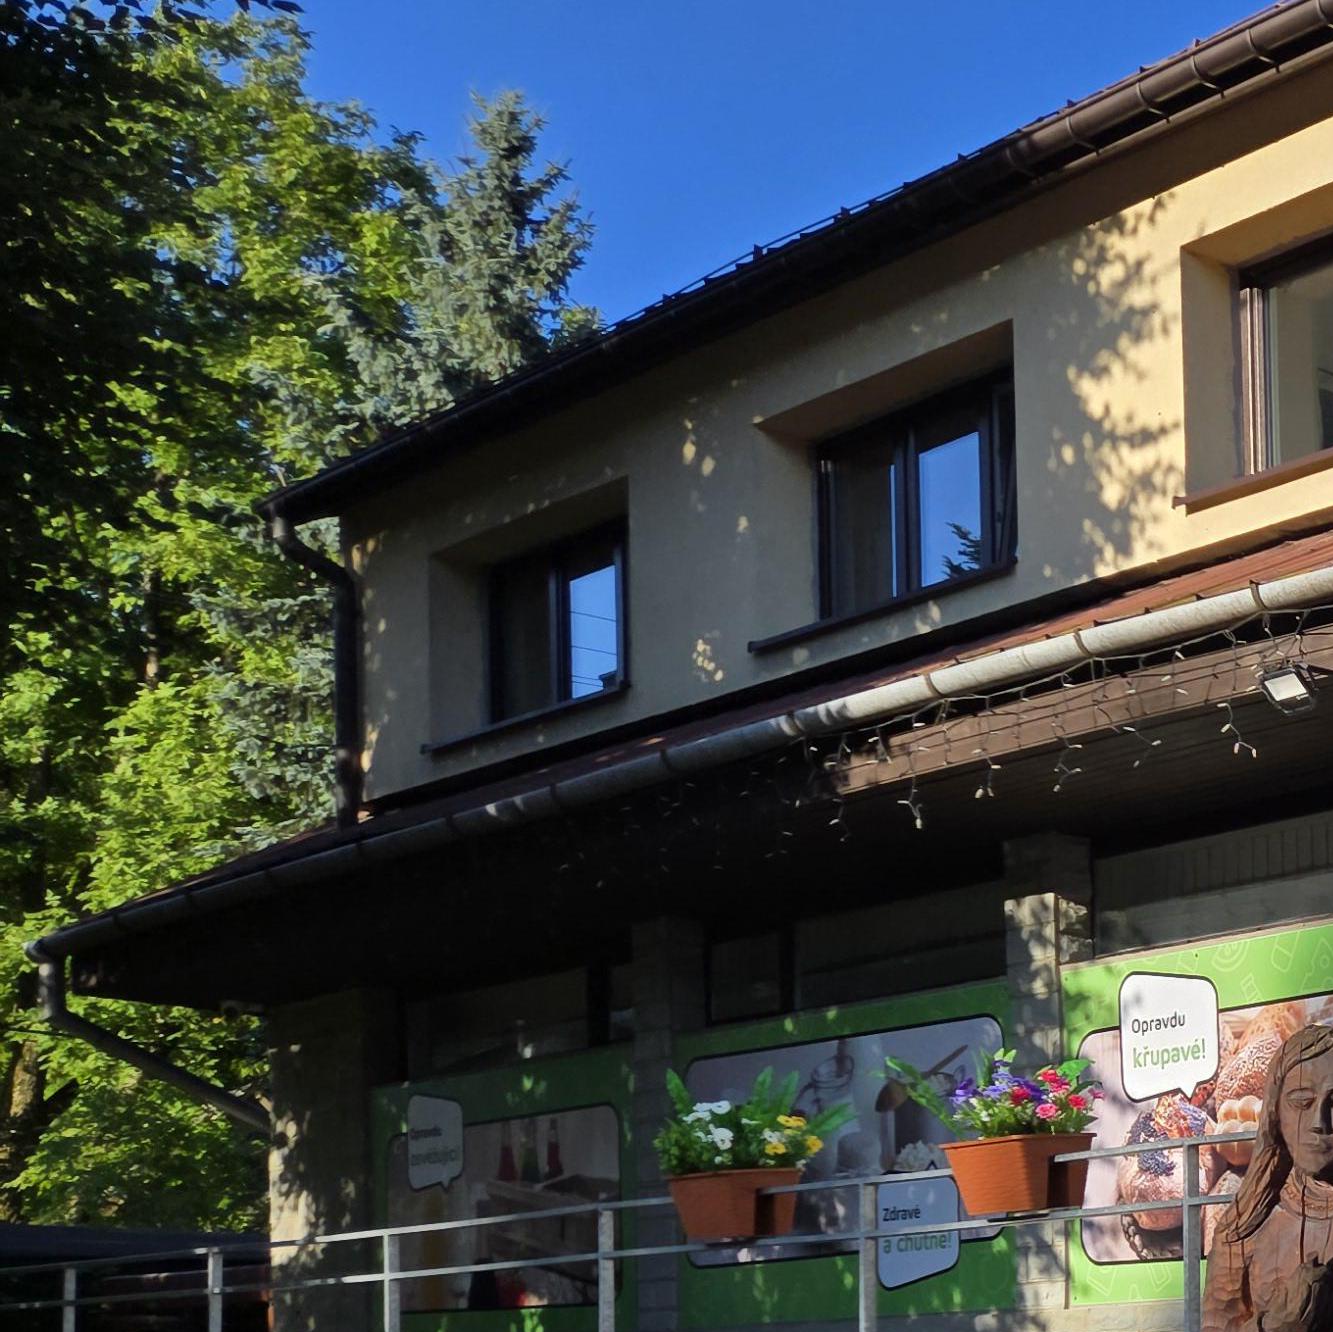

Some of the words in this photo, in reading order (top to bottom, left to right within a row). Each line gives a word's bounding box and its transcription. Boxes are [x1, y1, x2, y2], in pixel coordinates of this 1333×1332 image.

[1132, 1011, 1185, 1036] Opravdu
[1132, 1038, 1206, 1070] křupavé!
[882, 1204, 921, 1222] Zdravé
[883, 1239, 892, 1254] a
